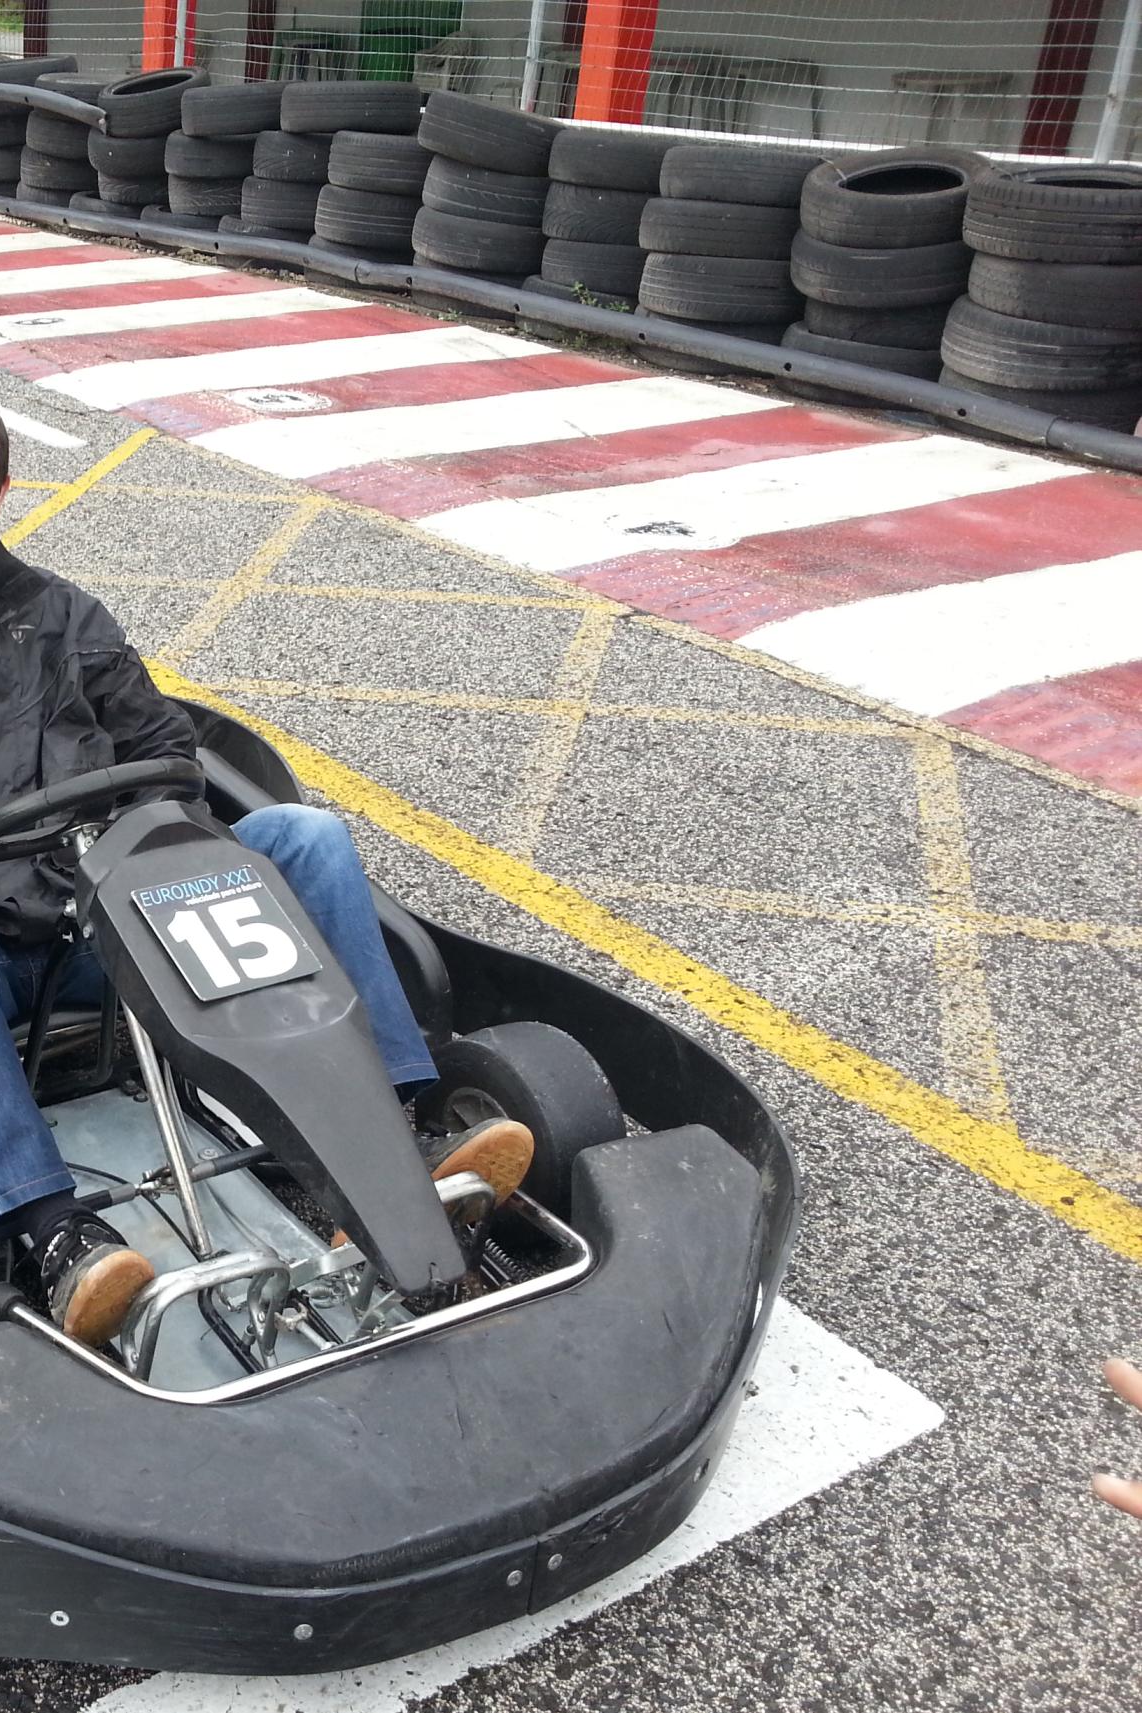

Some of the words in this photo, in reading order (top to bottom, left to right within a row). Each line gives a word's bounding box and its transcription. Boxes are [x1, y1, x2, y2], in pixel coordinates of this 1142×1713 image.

[139, 876, 219, 907] EUROINDY
[222, 868, 252, 887] XXI
[167, 896, 298, 988] 15
